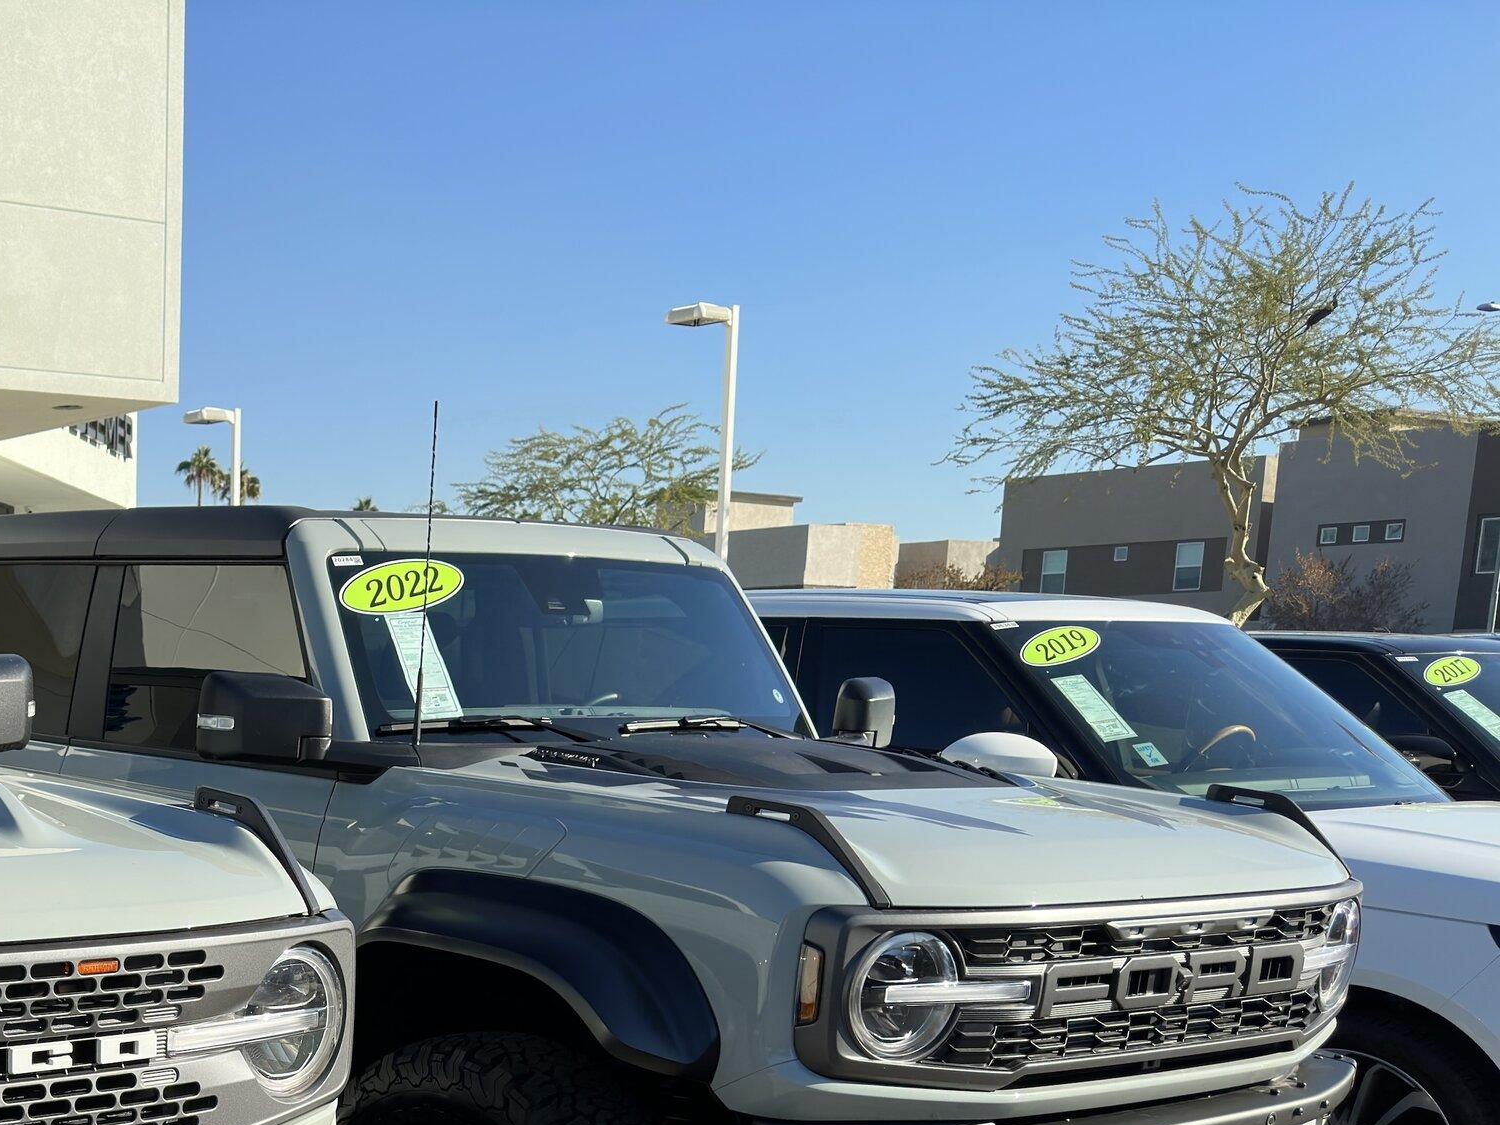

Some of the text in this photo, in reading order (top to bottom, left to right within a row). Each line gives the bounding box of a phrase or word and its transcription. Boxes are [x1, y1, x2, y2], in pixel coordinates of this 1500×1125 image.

[365, 566, 443, 608] 2022
[1035, 629, 1088, 662] 2019
[1433, 658, 1473, 683] 2017
[1039, 940, 1306, 1018] FORD
